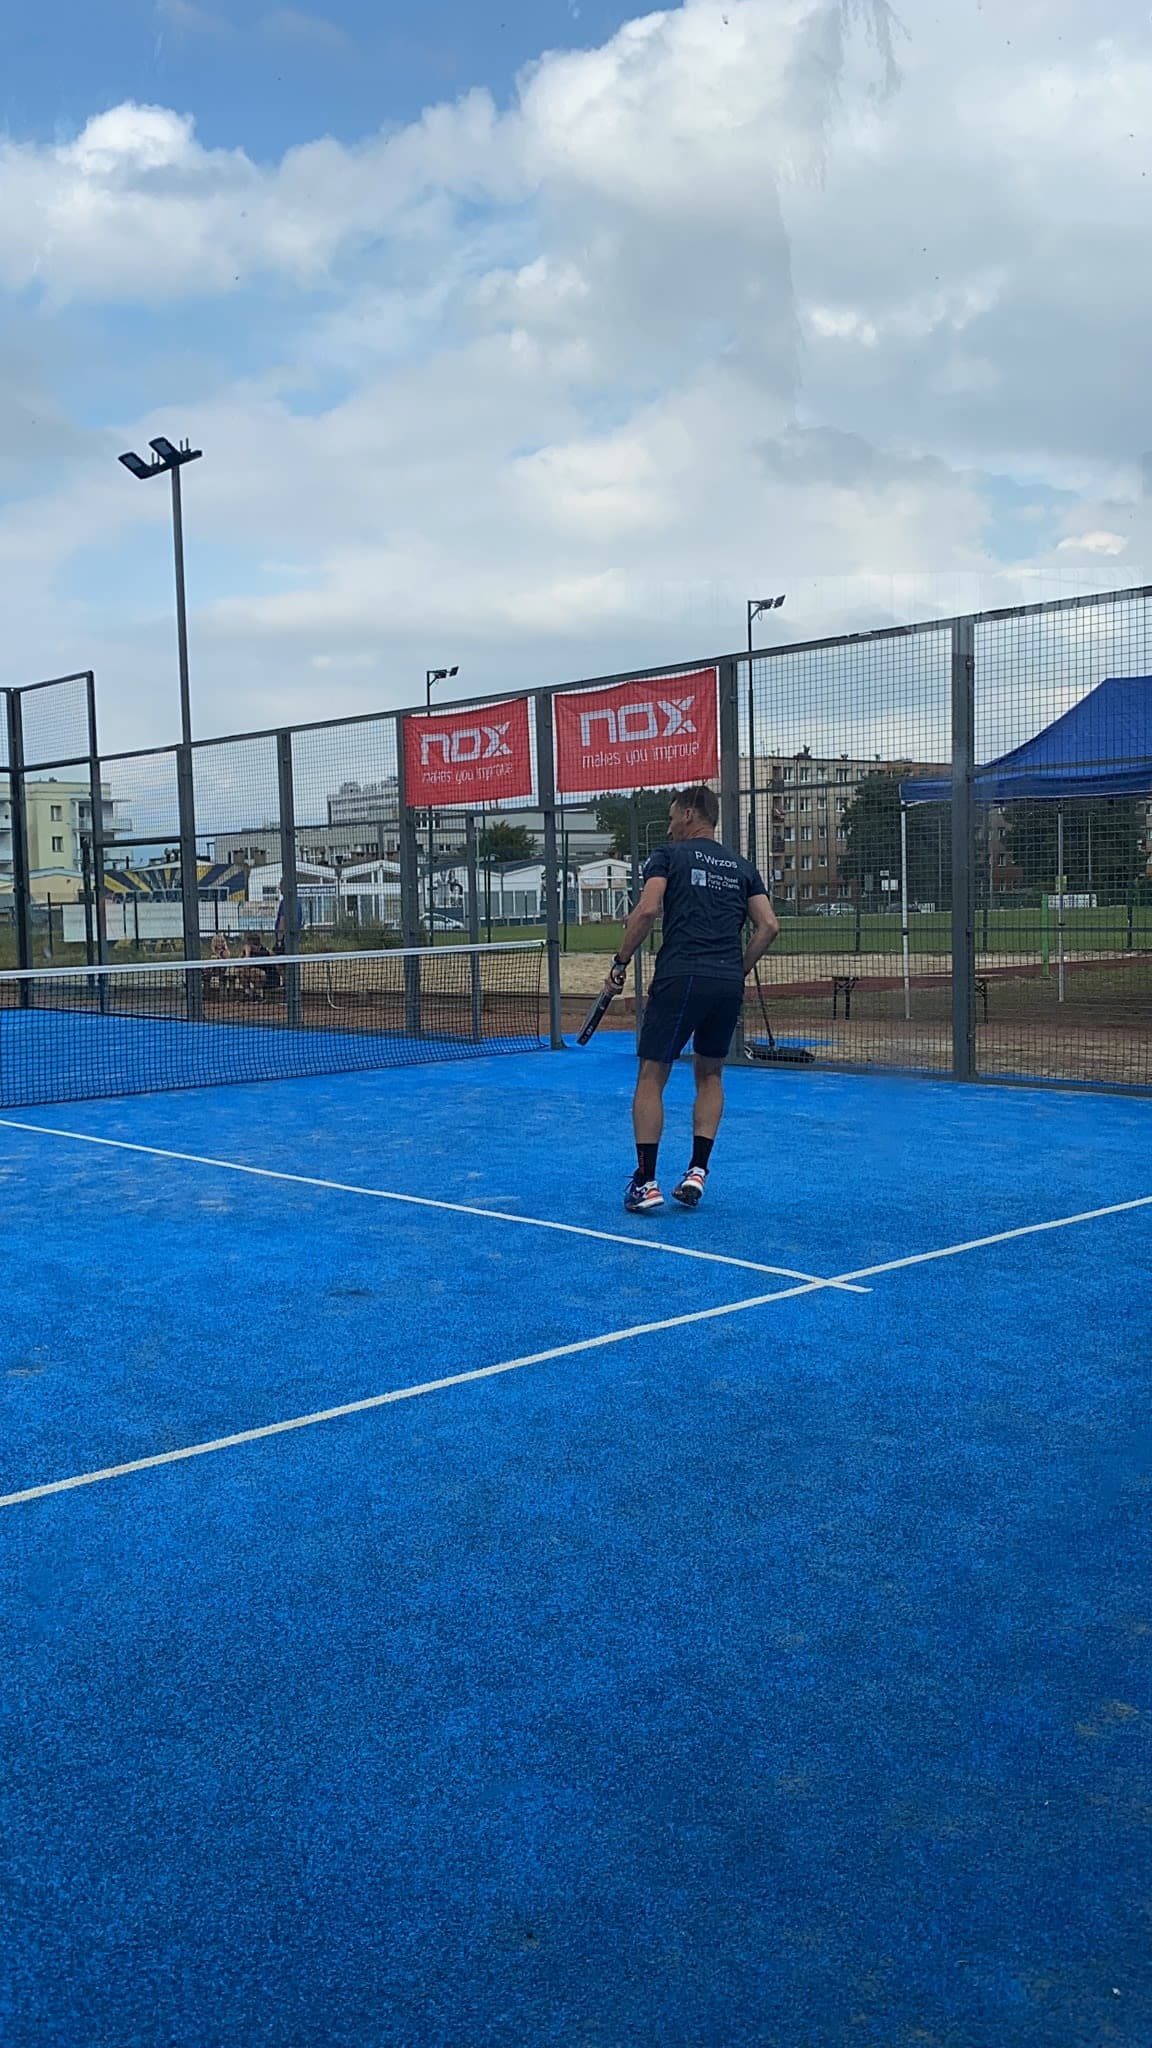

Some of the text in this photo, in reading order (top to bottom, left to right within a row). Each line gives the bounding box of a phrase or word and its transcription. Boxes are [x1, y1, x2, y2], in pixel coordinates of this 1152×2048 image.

[582, 741, 699, 769] makes you improve
[421, 768, 453, 784] makes
[455, 770, 474, 785] you
